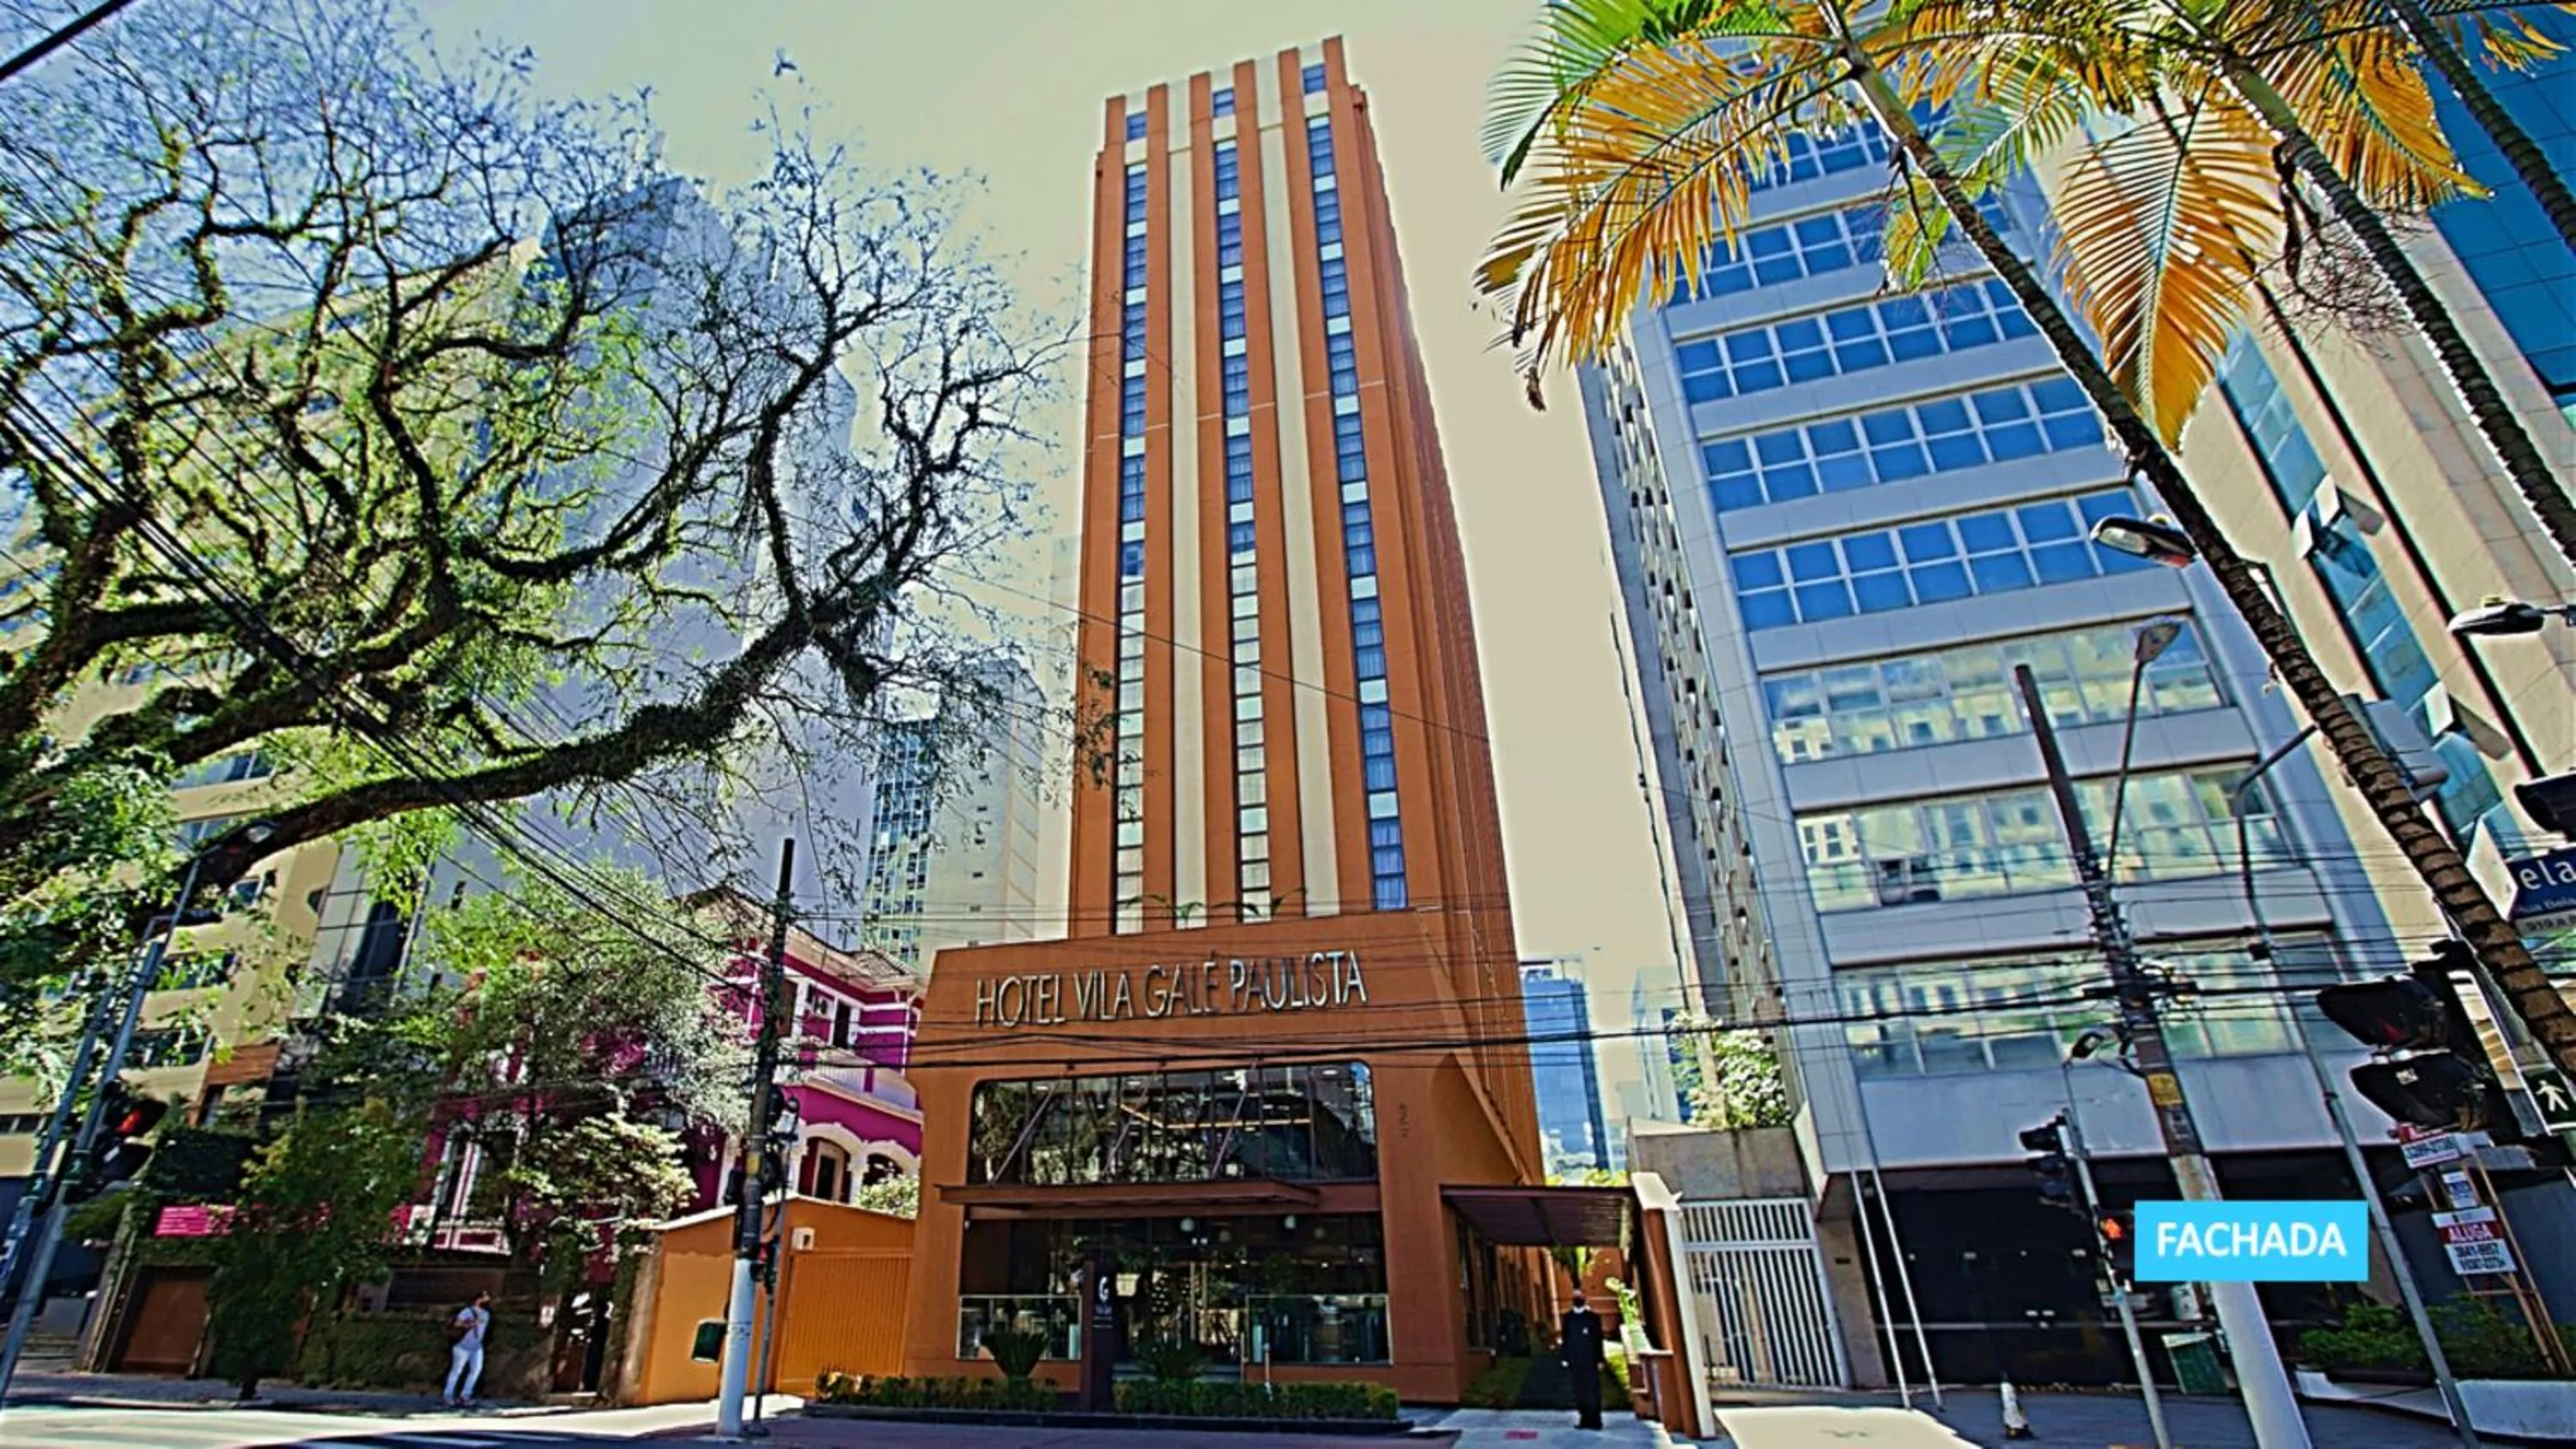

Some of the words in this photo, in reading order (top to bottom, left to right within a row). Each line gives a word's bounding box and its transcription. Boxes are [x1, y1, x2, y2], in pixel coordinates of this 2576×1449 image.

[2518, 859, 2576, 889] ela
[975, 974, 1066, 1028] HOTEL
[1073, 969, 1133, 1021] VILA
[1144, 951, 1218, 1018] GALÉ
[1230, 949, 1370, 1014] PAULISTA
[2448, 1222, 2495, 1243] ALUGA
